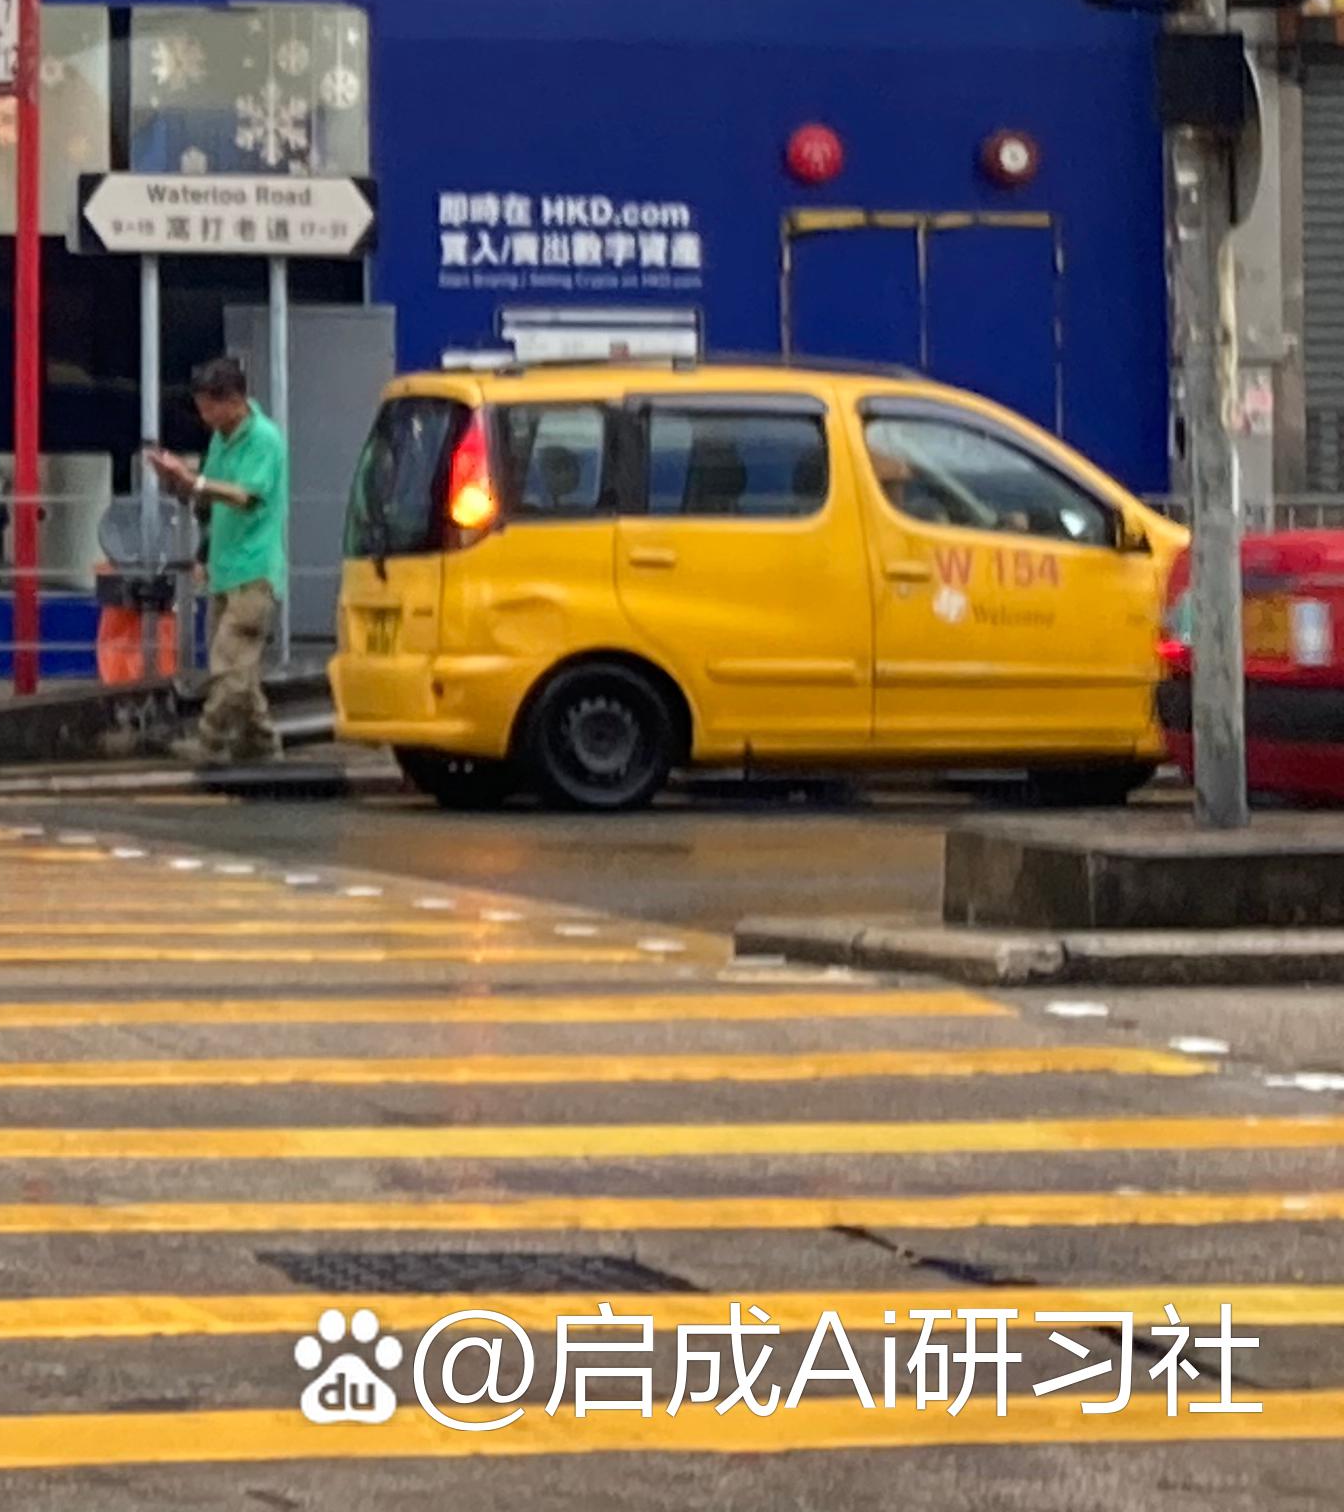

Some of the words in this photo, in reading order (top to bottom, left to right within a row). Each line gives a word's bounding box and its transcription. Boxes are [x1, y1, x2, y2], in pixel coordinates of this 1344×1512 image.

[147, 184, 246, 205] Waterloo
[256, 186, 310, 206] Road
[541, 194, 690, 227] HKD.com
